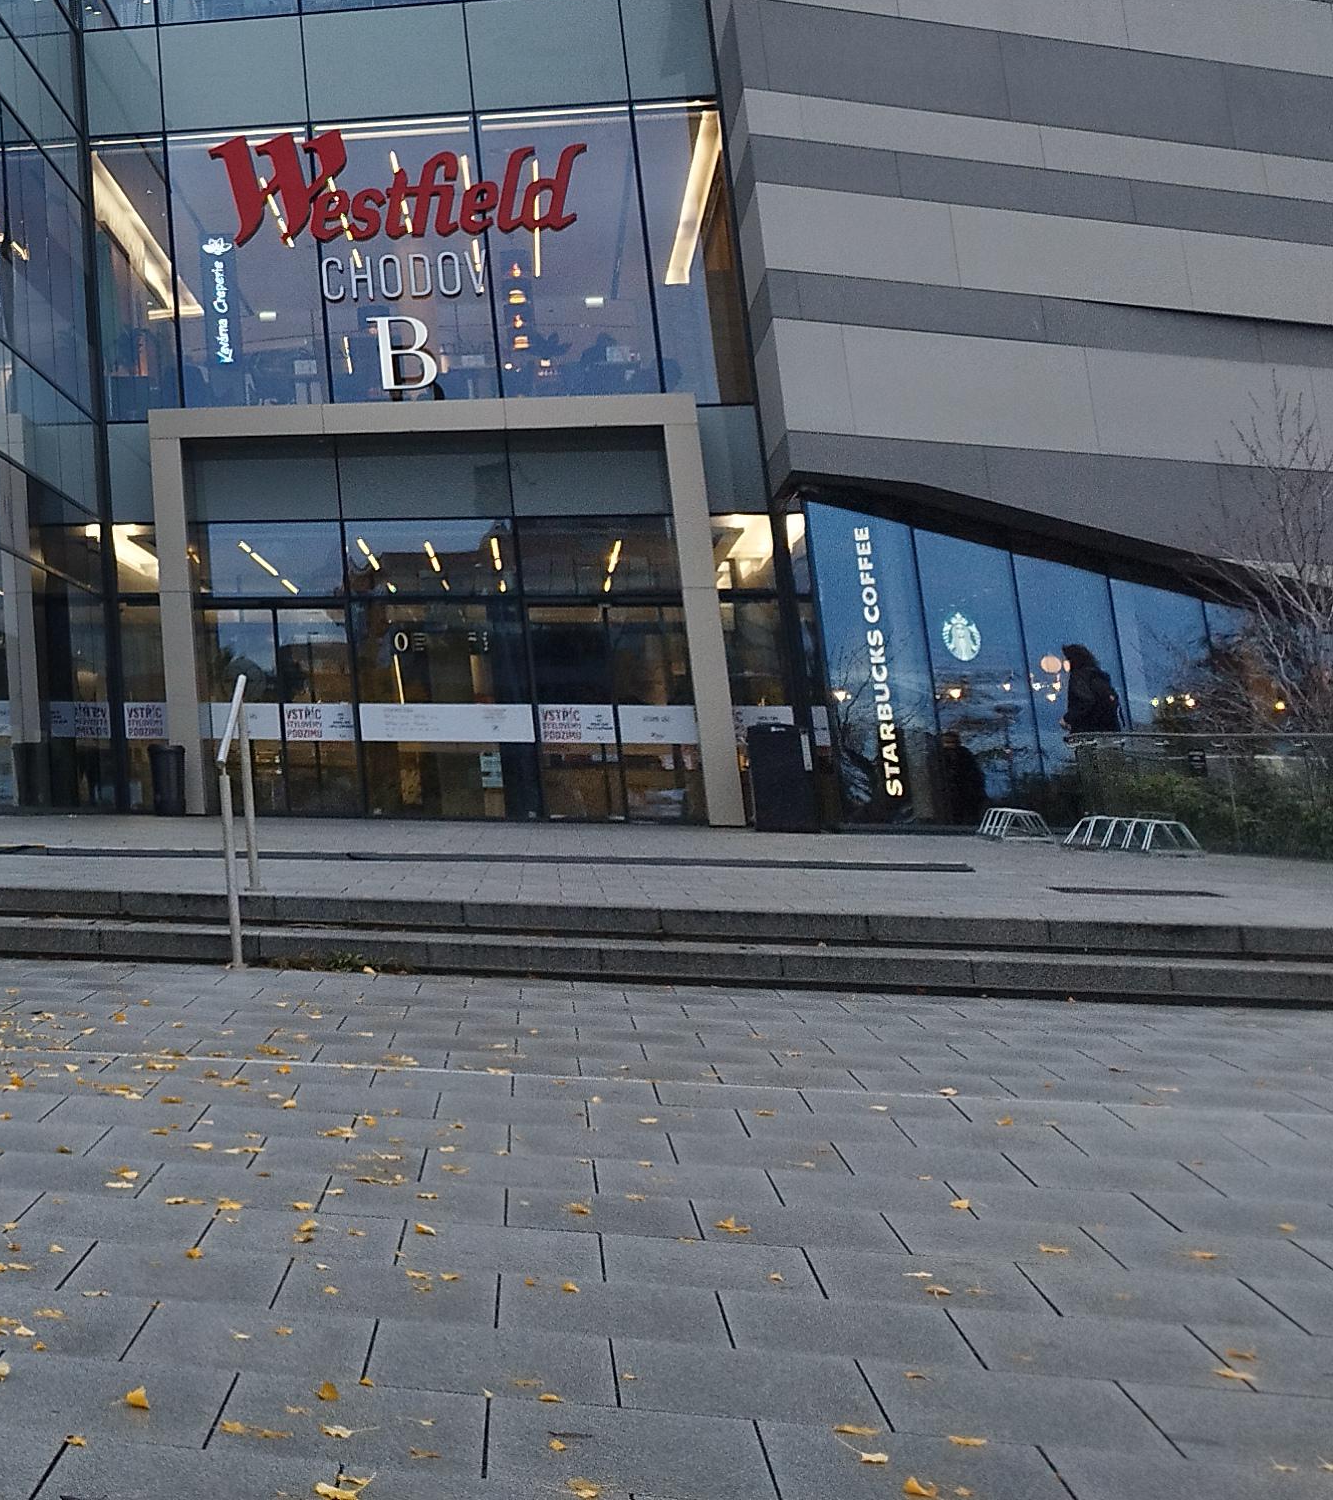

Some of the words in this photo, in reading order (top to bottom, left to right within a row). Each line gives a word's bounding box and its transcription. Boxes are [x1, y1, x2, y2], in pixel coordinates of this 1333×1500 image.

[208, 129, 587, 247] Westfield
[321, 249, 487, 302] CHODOV
[366, 316, 438, 391] B
[854, 526, 880, 623] COFFEE
[867, 629, 903, 797] STARBUCKS
